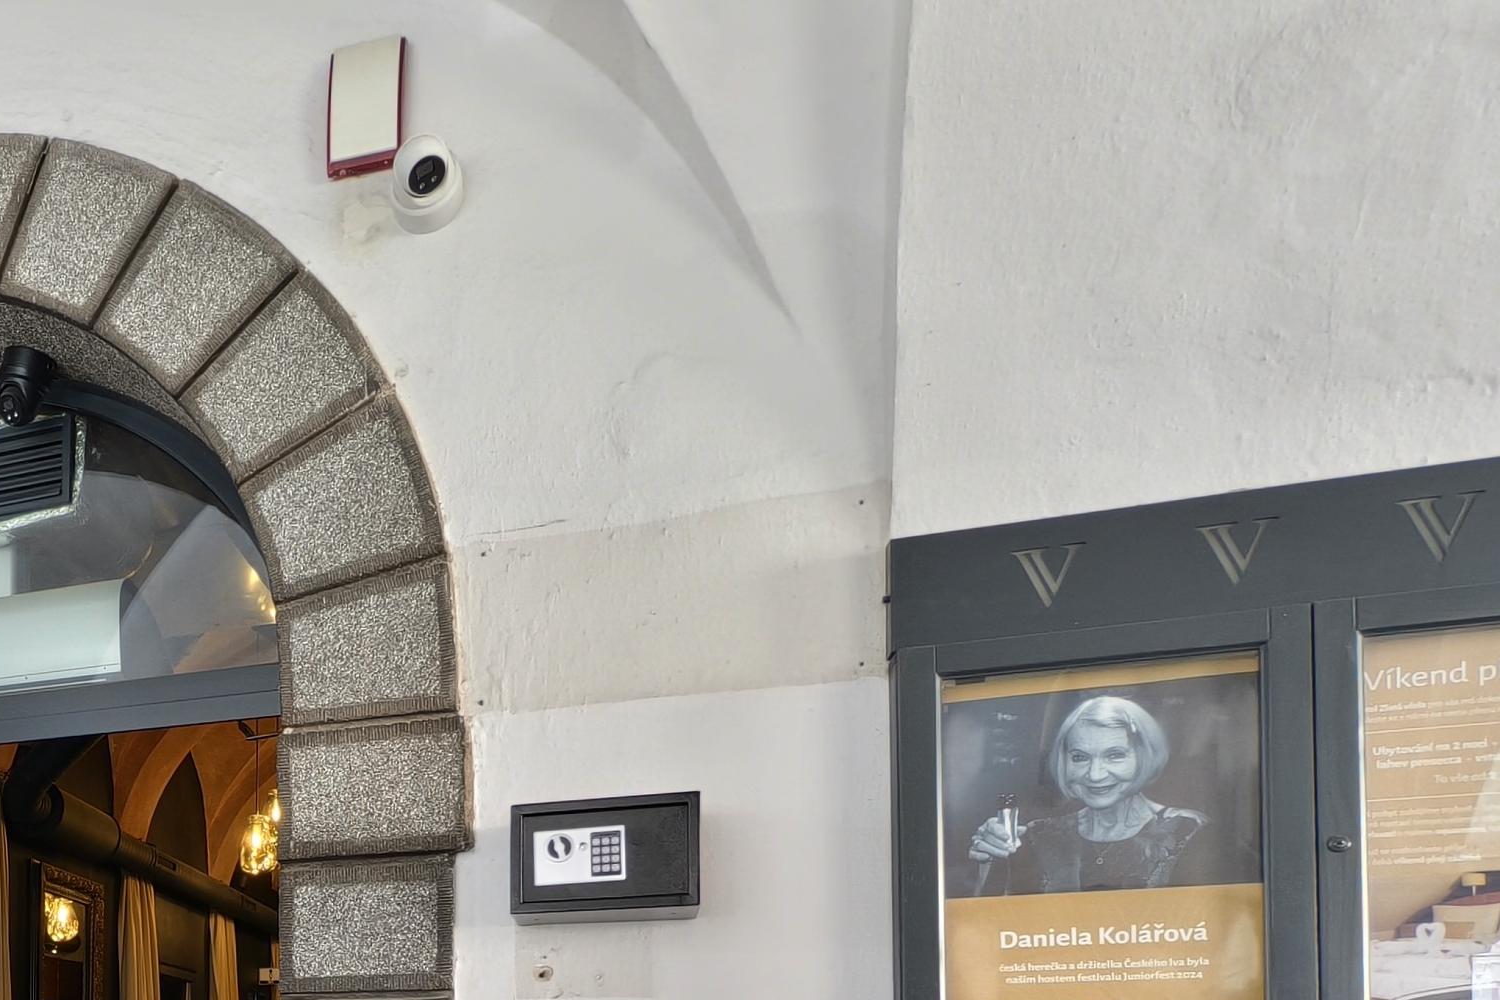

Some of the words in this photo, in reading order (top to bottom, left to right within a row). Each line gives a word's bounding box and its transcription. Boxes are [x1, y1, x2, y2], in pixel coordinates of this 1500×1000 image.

[1363, 660, 1468, 691] Víkend
[999, 927, 1093, 949] Daniela
[1098, 921, 1209, 945] Kolářová
[1076, 959, 1122, 971] držitelka
[1186, 956, 1210, 968] byla
[1037, 973, 1076, 984] hostem
[1077, 971, 1122, 983] festivalu
